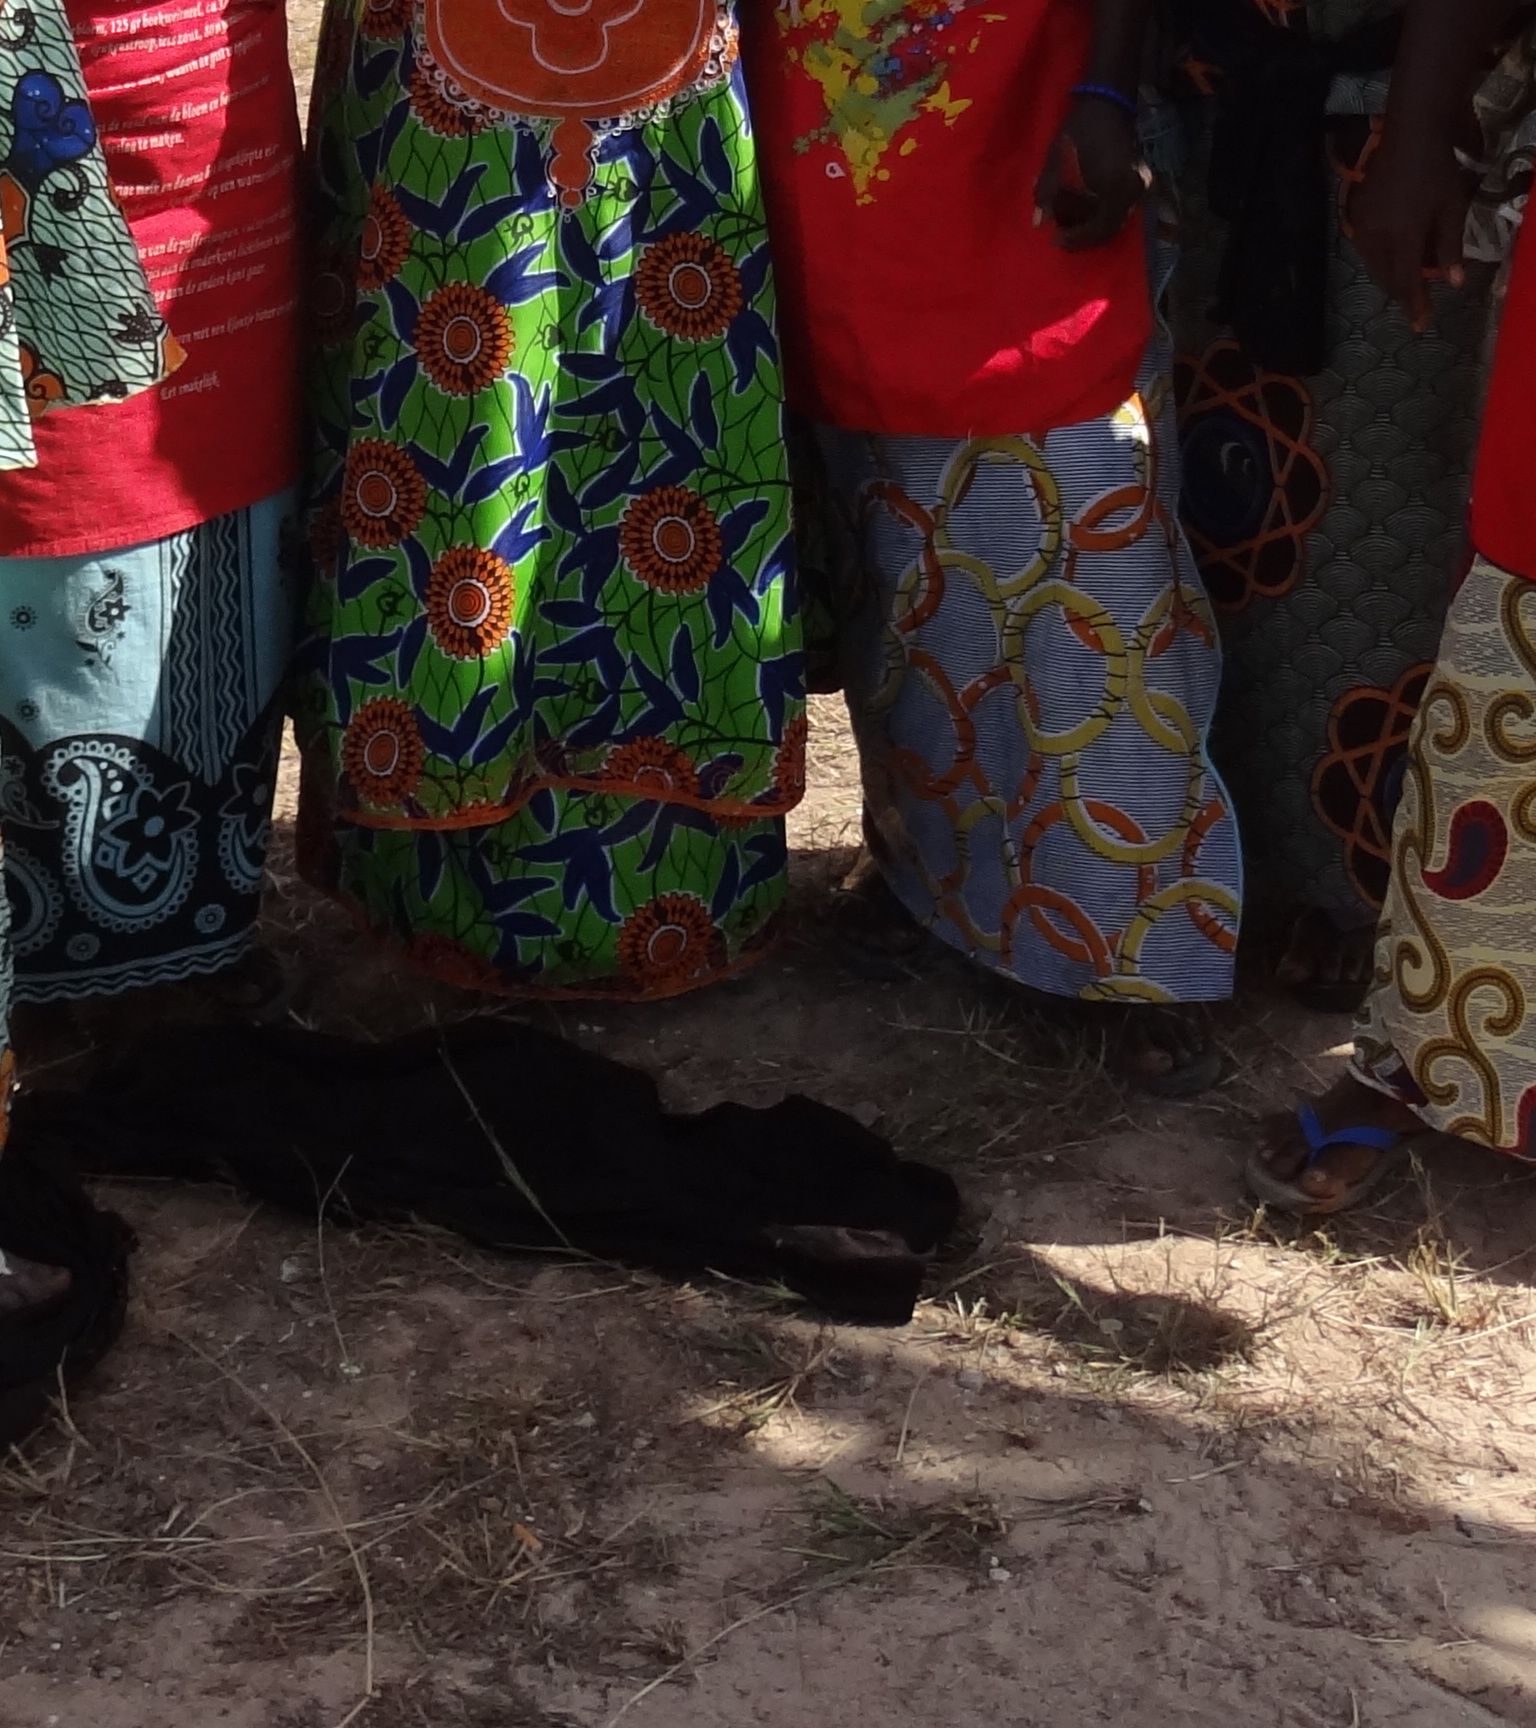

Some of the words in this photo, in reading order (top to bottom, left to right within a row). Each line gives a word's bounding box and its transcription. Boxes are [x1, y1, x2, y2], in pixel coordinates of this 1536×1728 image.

[111, 18, 129, 34] 125
[169, 106, 181, 122] de
[182, 99, 208, 120] bloem
[150, 132, 185, 151] maken.
[148, 243, 166, 258] van
